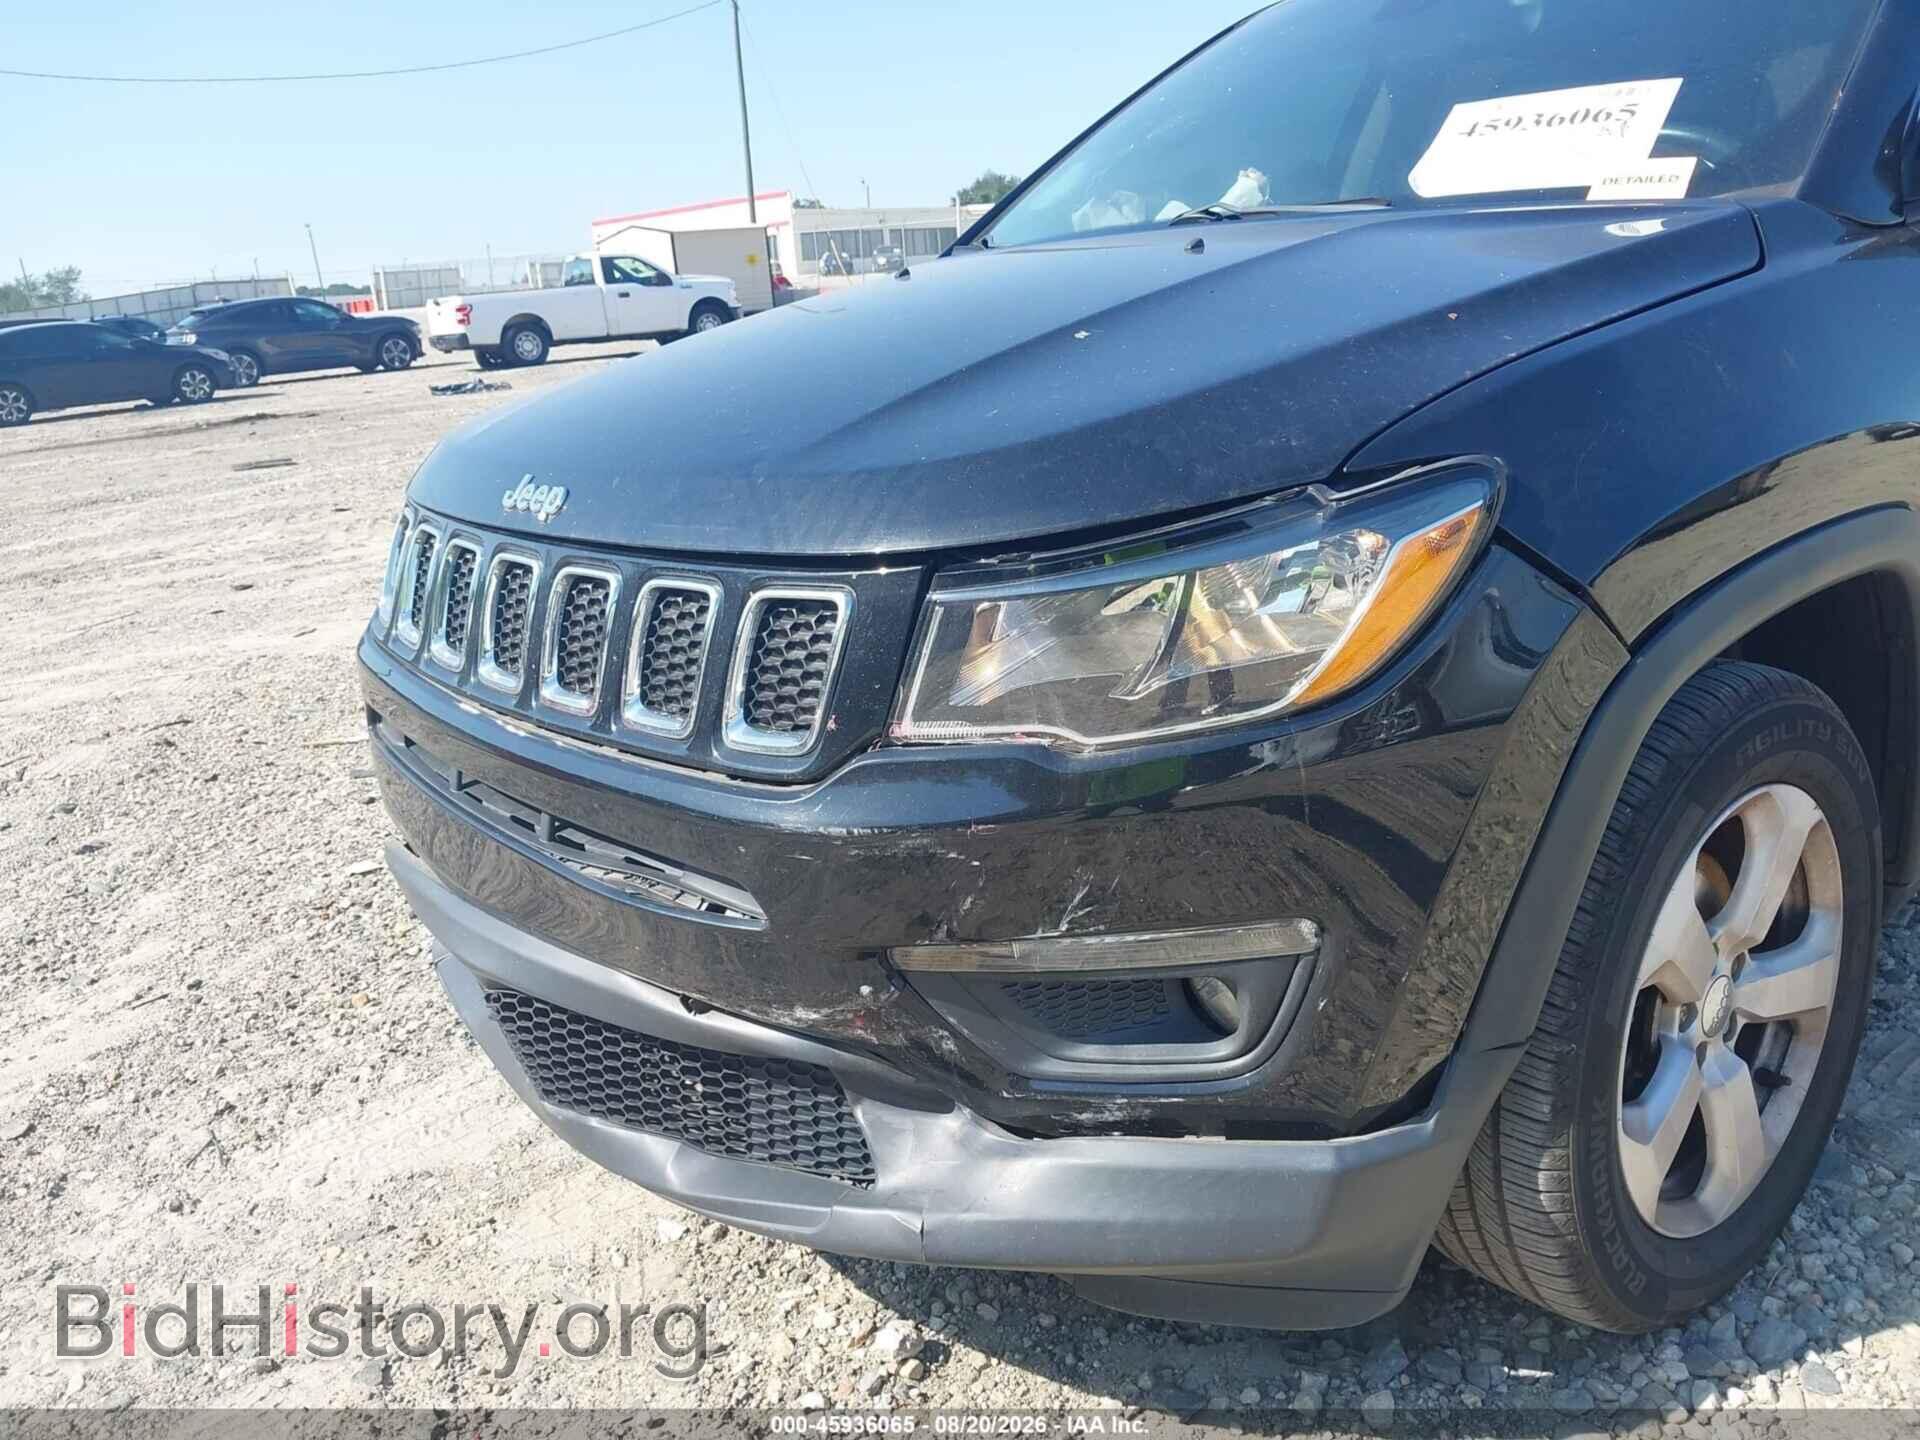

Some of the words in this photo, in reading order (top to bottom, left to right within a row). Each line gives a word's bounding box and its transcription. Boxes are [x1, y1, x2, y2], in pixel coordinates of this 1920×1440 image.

[1459, 103, 1640, 137] 45936065
[1602, 173, 1680, 186] DETAILED
[502, 473, 567, 521] Jeep
